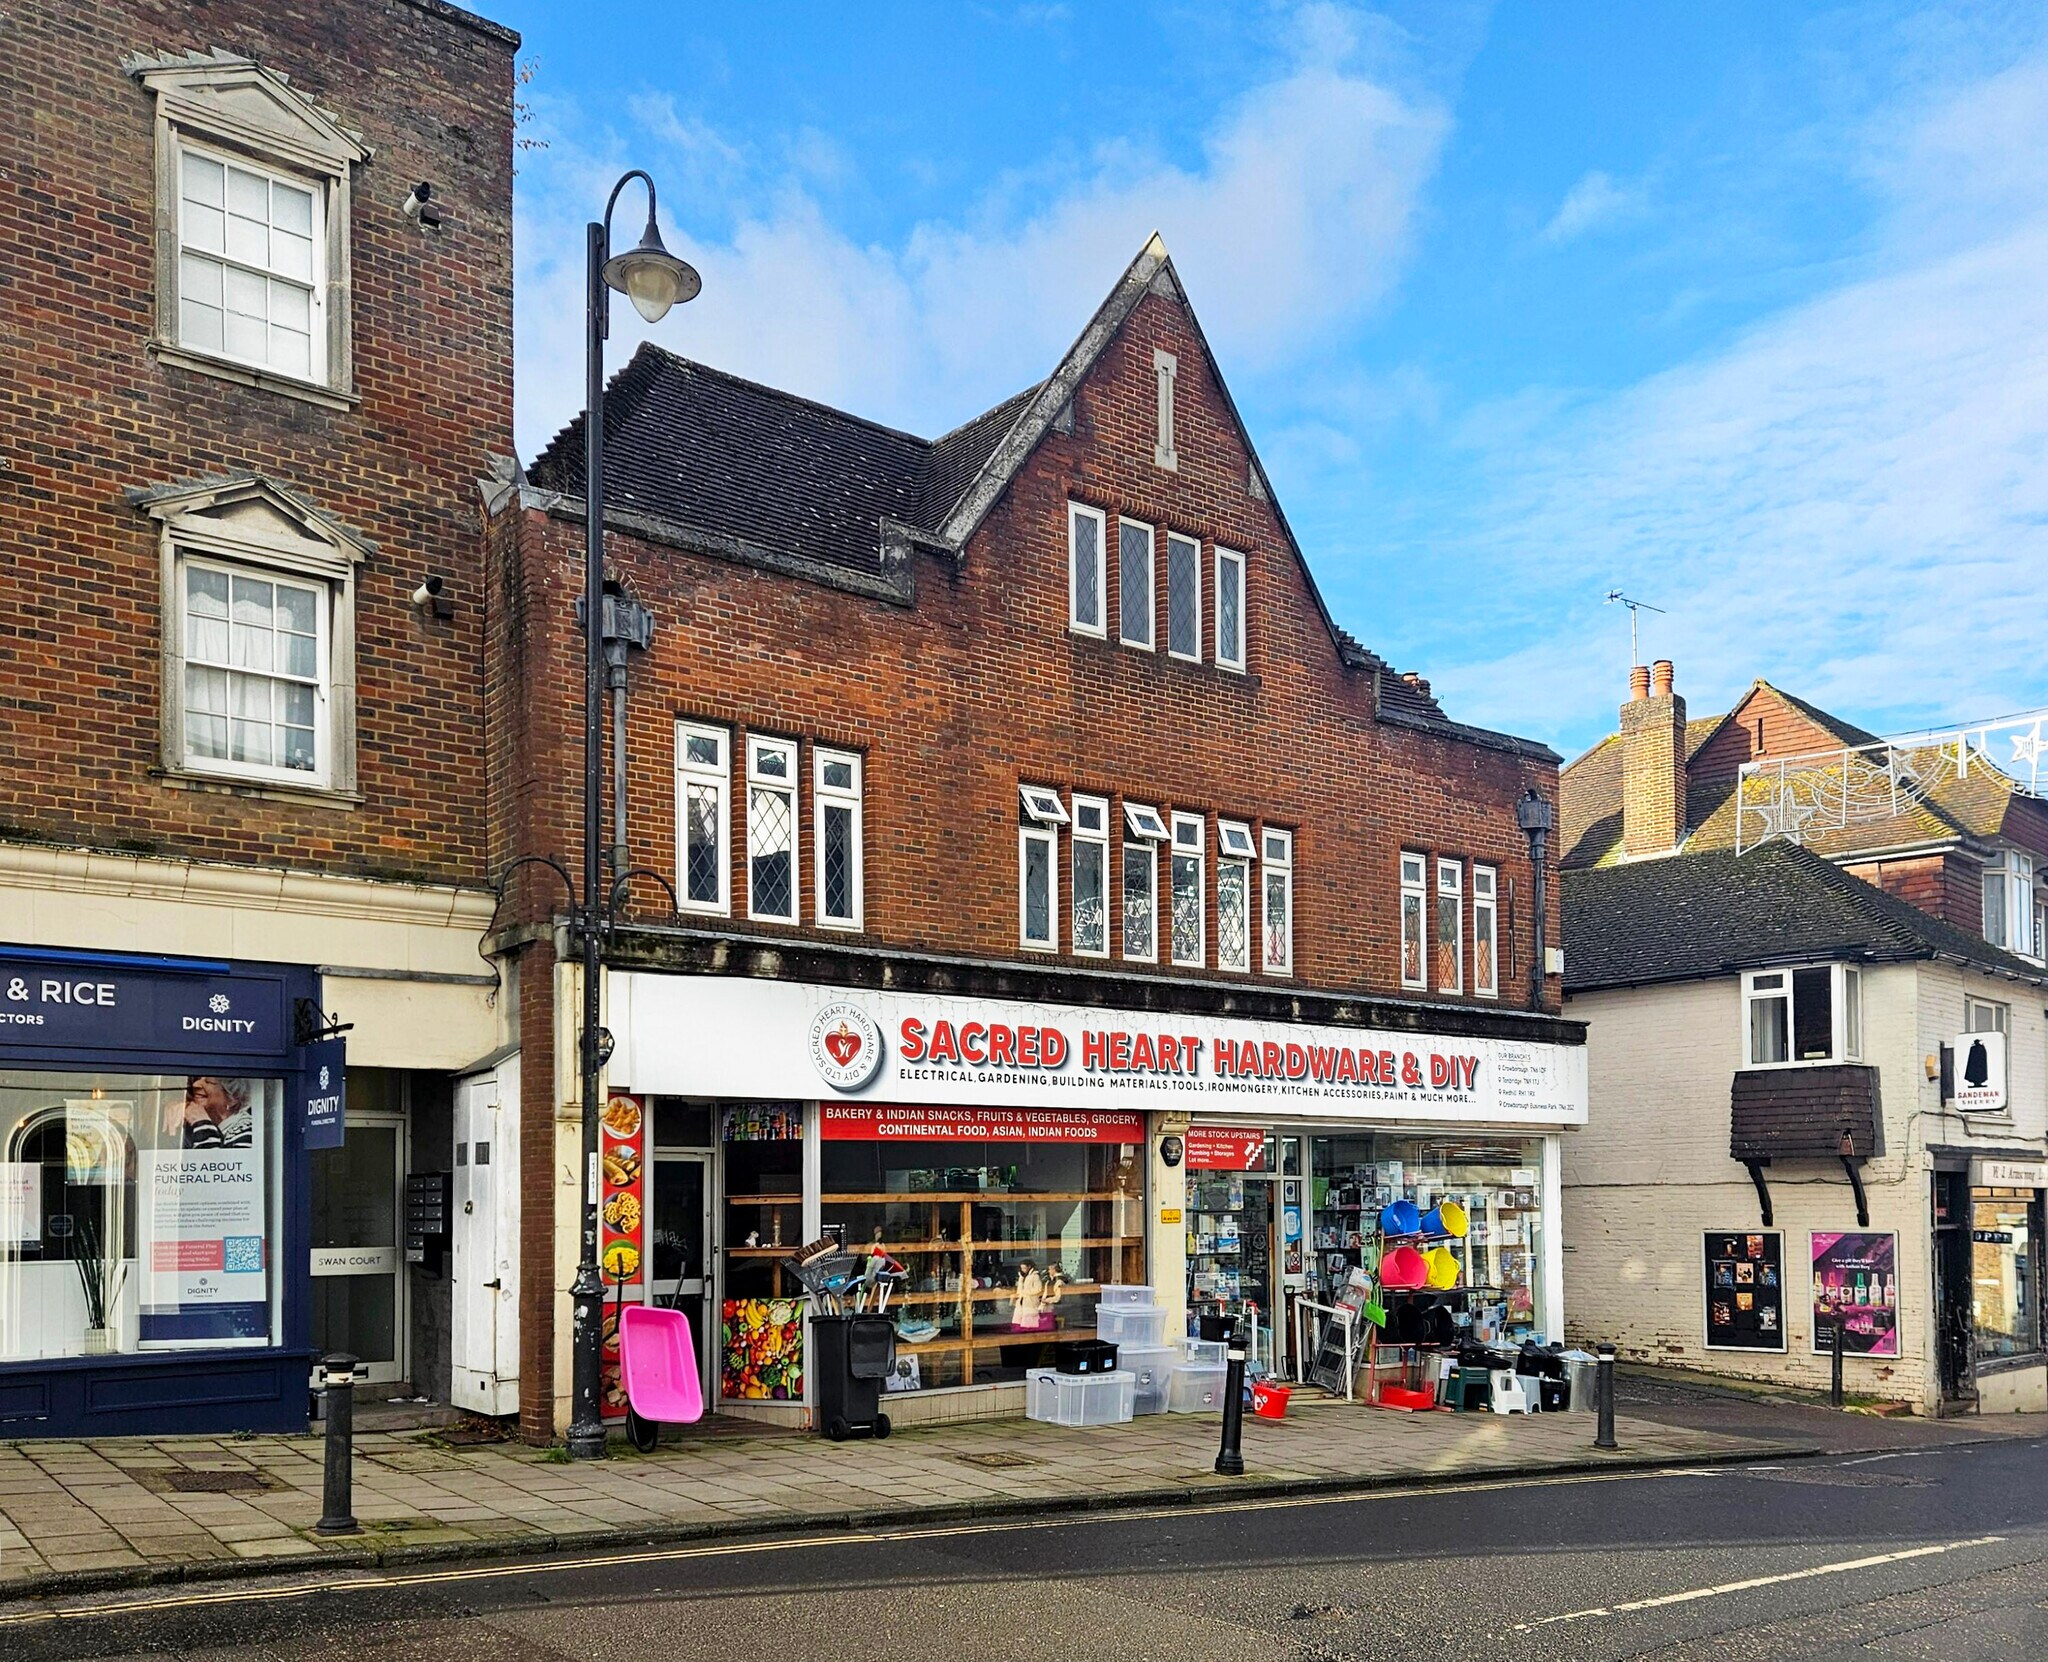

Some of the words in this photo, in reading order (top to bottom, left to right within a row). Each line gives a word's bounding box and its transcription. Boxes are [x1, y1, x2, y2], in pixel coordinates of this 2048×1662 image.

[6, 978, 29, 1001] &
[40, 980, 116, 1006] RICE
[819, 1006, 846, 1024] HEART
[182, 1017, 255, 1033] DIGNITY
[849, 1009, 875, 1062] HARDWARE
[812, 1025, 827, 1068] SACRED
[899, 1018, 1070, 1069] SACRED
[1082, 1030, 1202, 1075] HEART
[1213, 1037, 1397, 1085] HARDWARE
[1401, 1051, 1423, 1086] &
[1430, 1052, 1479, 1091] DIY
[825, 1067, 842, 1080] LTD
[844, 1069, 860, 1081] DIY
[1411, 1093, 1417, 1101] &
[1420, 1093, 1443, 1102] MUCH
[1447, 1094, 1476, 1104] MORE...
[1957, 1091, 1999, 1099] SANDEMAN
[308, 1096, 339, 1115] DIGNITY
[826, 1108, 873, 1120] BAKERY
[876, 1110, 883, 1120] &
[886, 1109, 924, 1121] INDIAN
[928, 1110, 974, 1122] SNACKS,
[977, 1111, 1013, 1122] FRUITS
[1016, 1112, 1023, 1122] &
[1025, 1112, 1090, 1125] VEGETABLES,
[1092, 1114, 1138, 1126] GROCERY,
[878, 1124, 955, 1136] CONTINENTAL
[957, 1125, 990, 1138] FOOD,
[992, 1126, 1025, 1138] ASIAN,
[1028, 1126, 1062, 1138] INDIAN
[1064, 1127, 1098, 1138] FOODS
[1188, 1130, 1206, 1138] MORE
[1207, 1131, 1229, 1139] STOCK
[1230, 1131, 1261, 1140] UPSTAIRS
[1188, 1142, 1212, 1150] Gardening
[1214, 1150, 1235, 1158] Storages
[155, 1162, 177, 1173] ASK
[181, 1162, 197, 1172] US
[200, 1162, 243, 1172] ABOUT
[155, 1174, 211, 1184] FUNERAL
[213, 1173, 253, 1183] PLANS
[154, 1186, 184, 1197] today
[1974, 1231, 2012, 1243] OPEN
[318, 1258, 346, 1266] SWAN
[349, 1256, 381, 1265] COURT
[187, 1287, 219, 1295] DIGNITY
